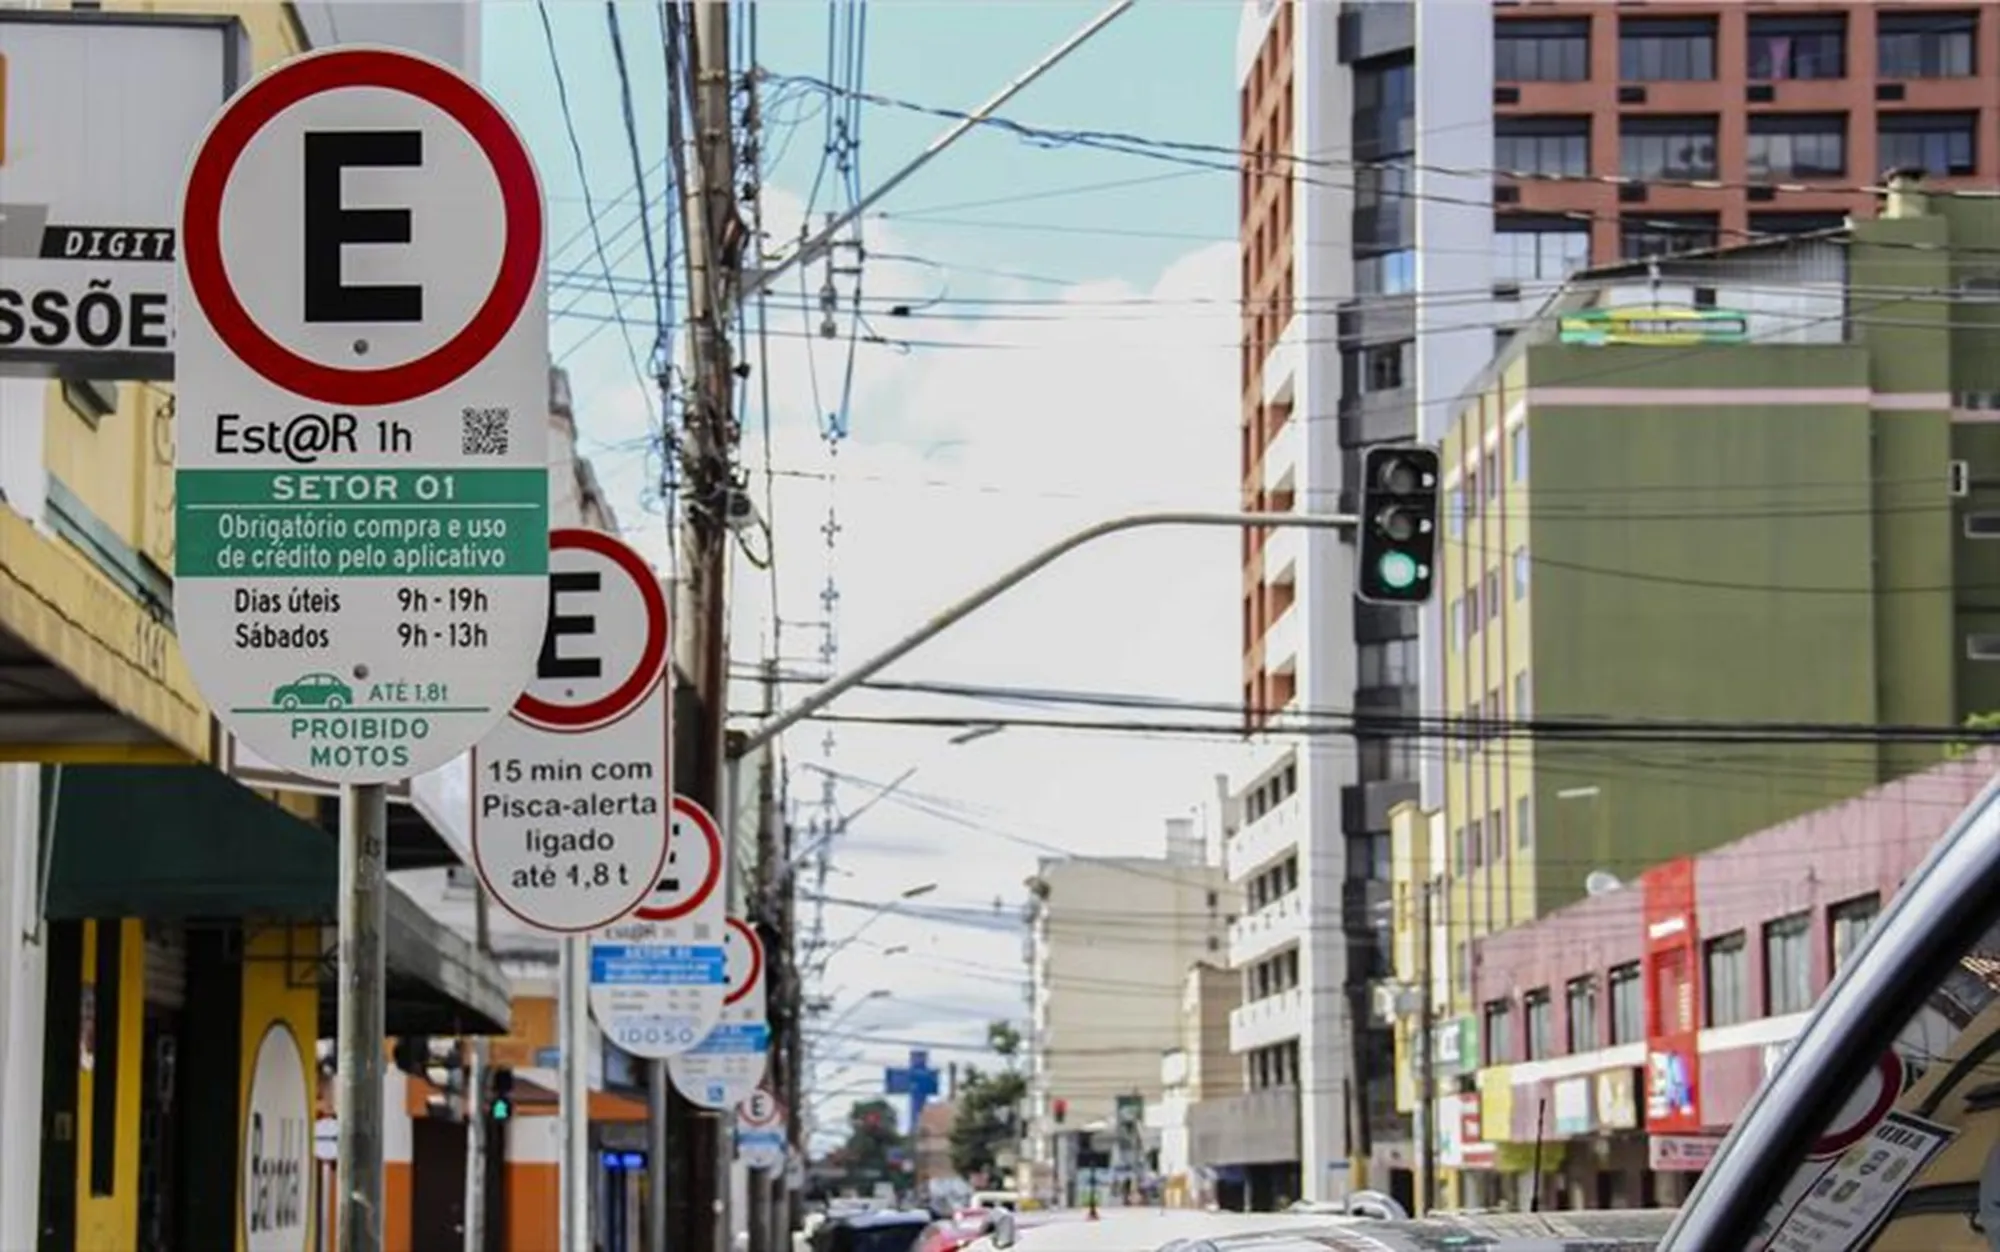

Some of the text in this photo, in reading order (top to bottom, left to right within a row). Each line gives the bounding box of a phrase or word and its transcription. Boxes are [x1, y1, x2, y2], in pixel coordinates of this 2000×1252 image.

[304, 131, 423, 322] E
[65, 231, 174, 258] DIGIT
[0, 279, 174, 347] SSÕE
[215, 414, 412, 463] Est@R 1h
[272, 475, 455, 500] SETOR 01
[218, 513, 507, 546] Obrigatório compra e uso
[217, 543, 506, 573] de crédito pelo aplicativo
[235, 588, 281, 613] Dias
[288, 586, 341, 613] úteis
[397, 588, 427, 613] 9h
[450, 588, 488, 613] 19h
[235, 621, 330, 648] Sábados
[397, 623, 427, 647] 9h
[450, 623, 488, 647] 13h
[537, 571, 602, 679] E
[368, 679, 407, 702] ATÉ
[291, 718, 430, 740] PROIBIDO
[310, 746, 410, 767] MOTOS
[488, 759, 653, 783] 15 min com
[483, 793, 658, 819] Pisca-alerta
[525, 829, 614, 858] ligado
[511, 862, 629, 889] até 1,8 t
